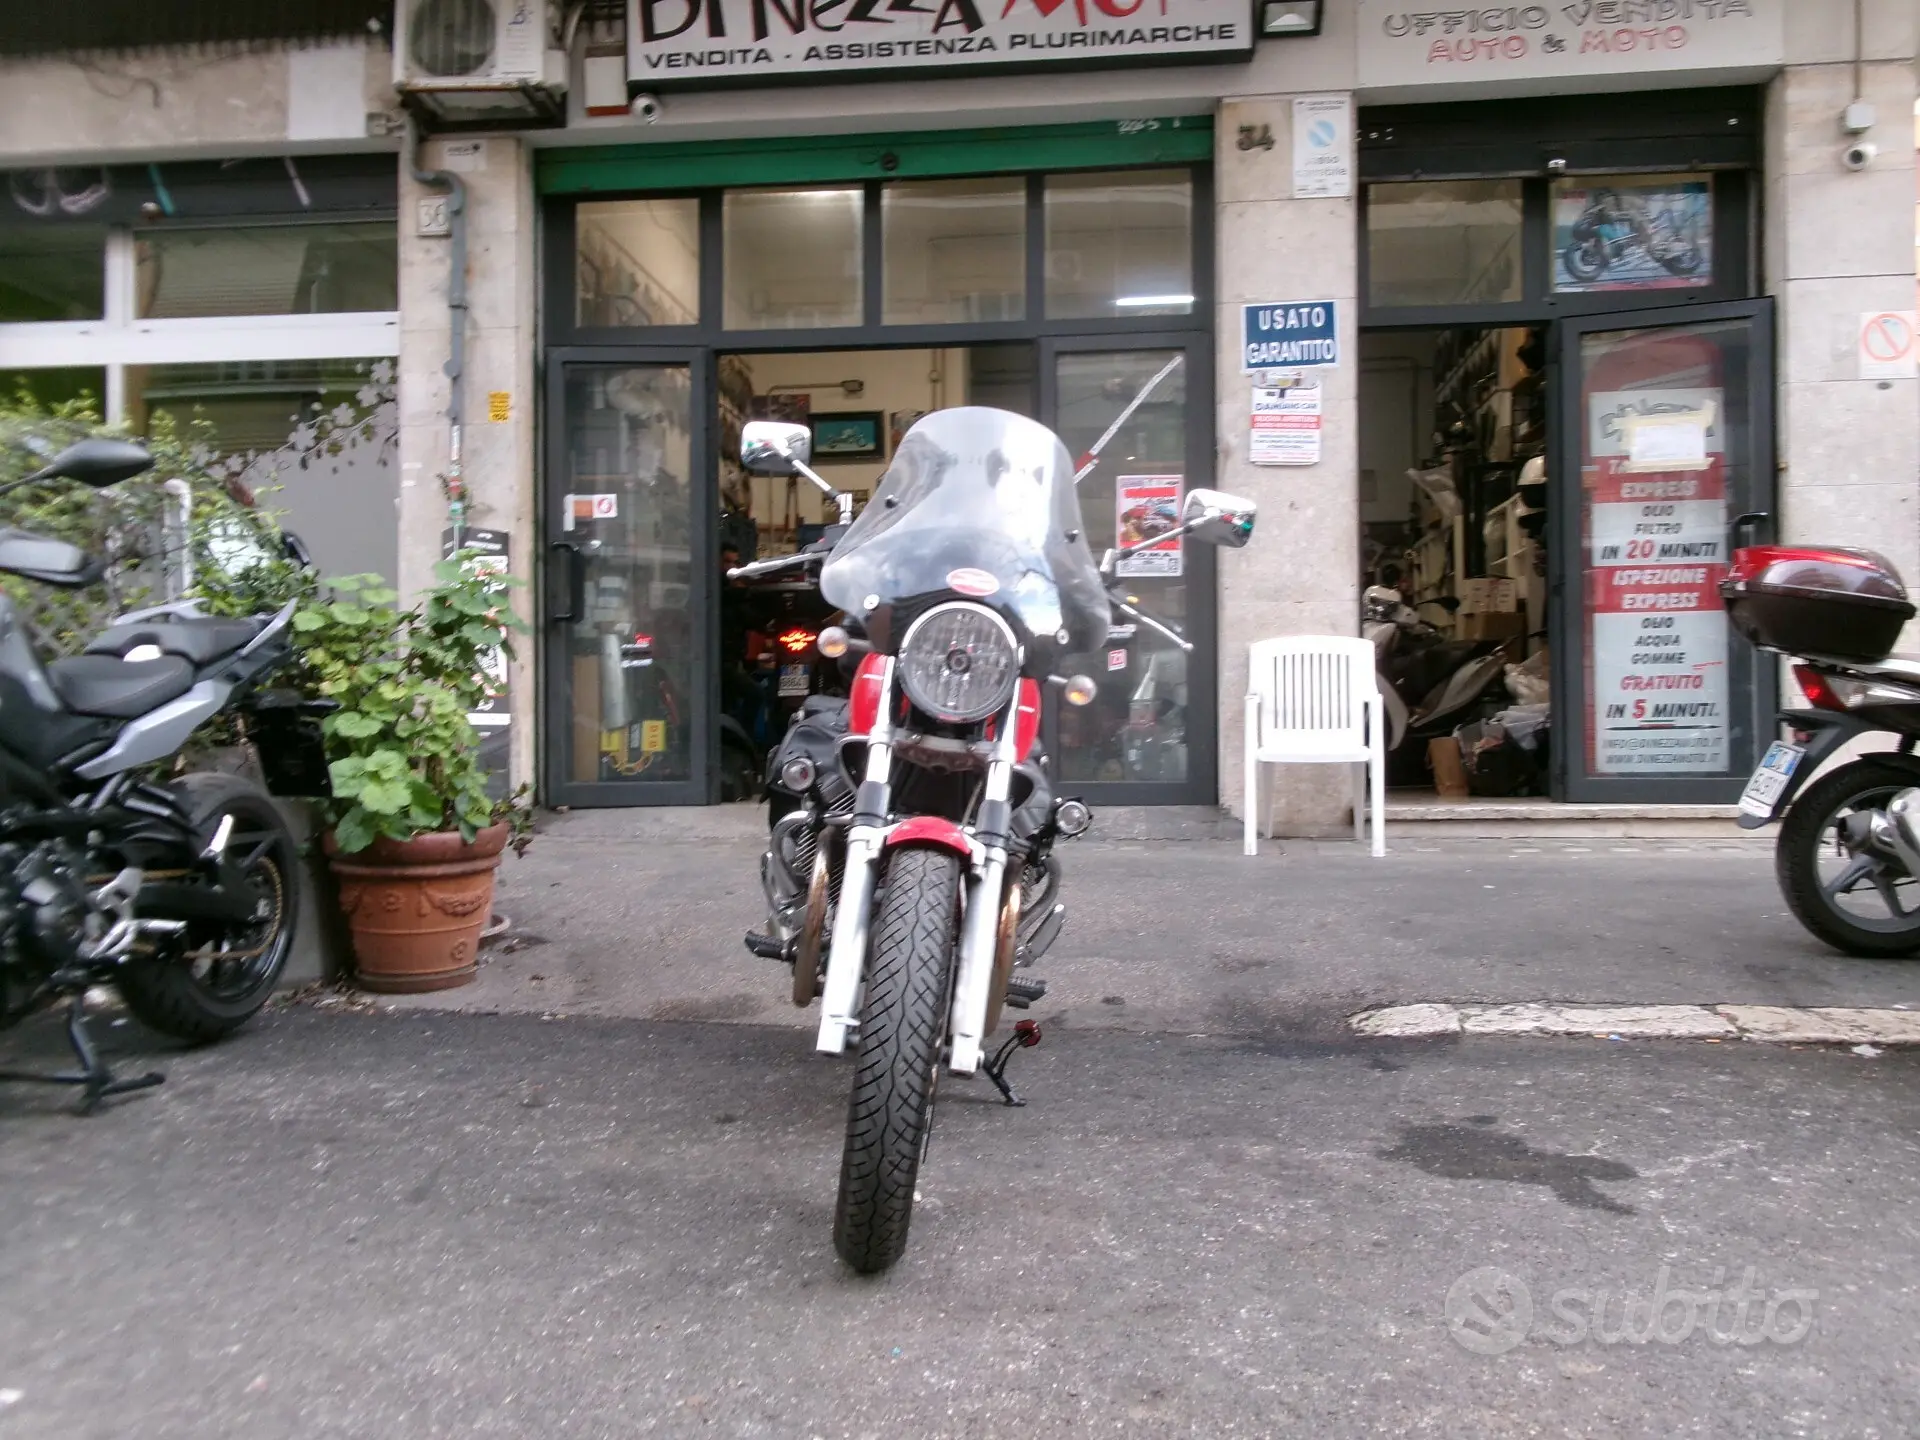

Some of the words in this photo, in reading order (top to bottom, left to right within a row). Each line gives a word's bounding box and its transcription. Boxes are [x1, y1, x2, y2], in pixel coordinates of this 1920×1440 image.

[1382, 5, 1549, 38] UFFICIO
[1561, 0, 1753, 27] VENDITA
[645, 47, 773, 69] VENDITA
[803, 36, 998, 62] ASSISTENZA
[1009, 23, 1236, 50] PLURIMARCHE
[1427, 35, 1529, 63] AUTO
[1541, 34, 1565, 54] &
[1578, 25, 1689, 54] MOTO
[1236, 123, 1276, 152] 34
[420, 202, 448, 228] 36
[1258, 306, 1326, 331] USATO
[1247, 339, 1336, 364] GARANTITO
[1620, 480, 1699, 498] EXPRESS
[1642, 505, 1675, 516] OLIO
[1601, 545, 1620, 560] IN
[1625, 540, 1656, 559] 20
[1657, 541, 1720, 557] MINUTI
[1612, 568, 1708, 586] ISPEZIONE
[1621, 592, 1699, 609] EXPRESS
[1641, 617, 1675, 629] OLIO
[1634, 634, 1681, 647] ACQUA
[1631, 652, 1687, 665] GOMME
[1620, 674, 1704, 691] GRATUITO
[1606, 703, 1628, 719] IN
[1632, 698, 1647, 719] 5
